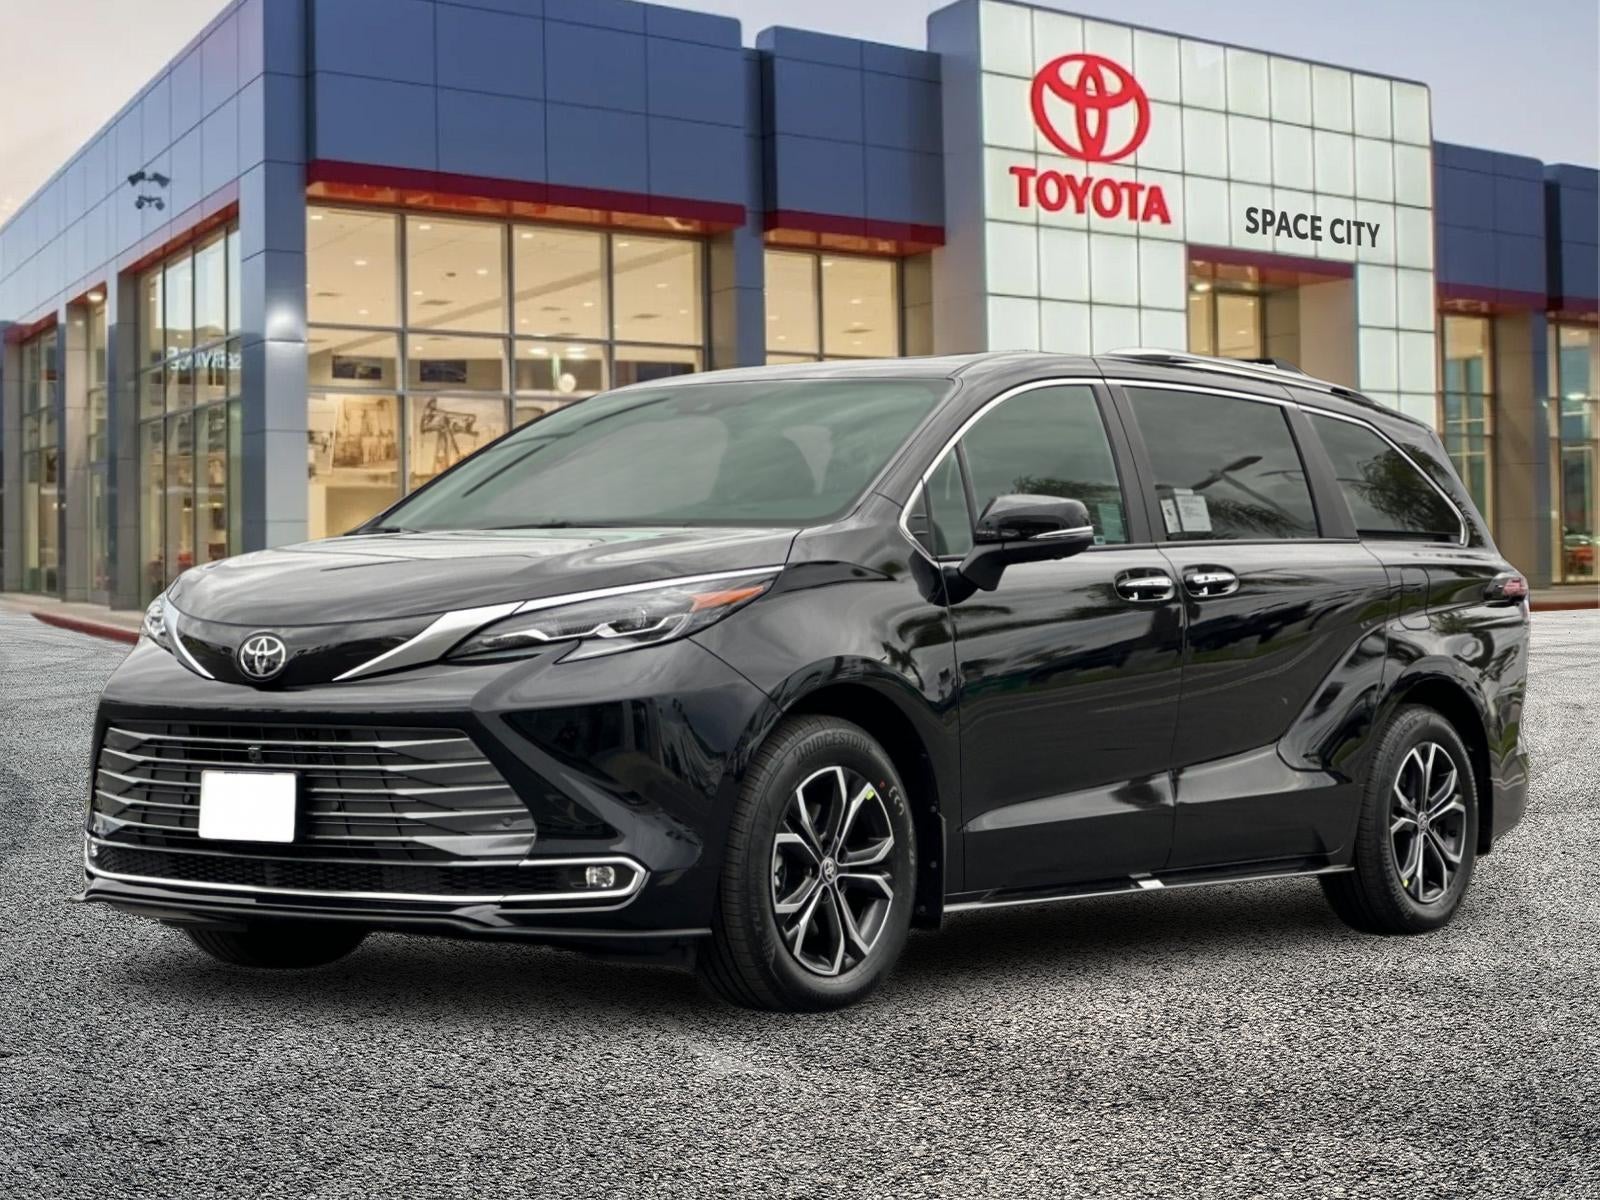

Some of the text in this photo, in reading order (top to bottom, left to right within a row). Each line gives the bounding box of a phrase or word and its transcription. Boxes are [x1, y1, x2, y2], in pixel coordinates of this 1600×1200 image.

[1009, 166, 1171, 224] TOYOTA
[1245, 206, 1380, 247] SPACE CITY
